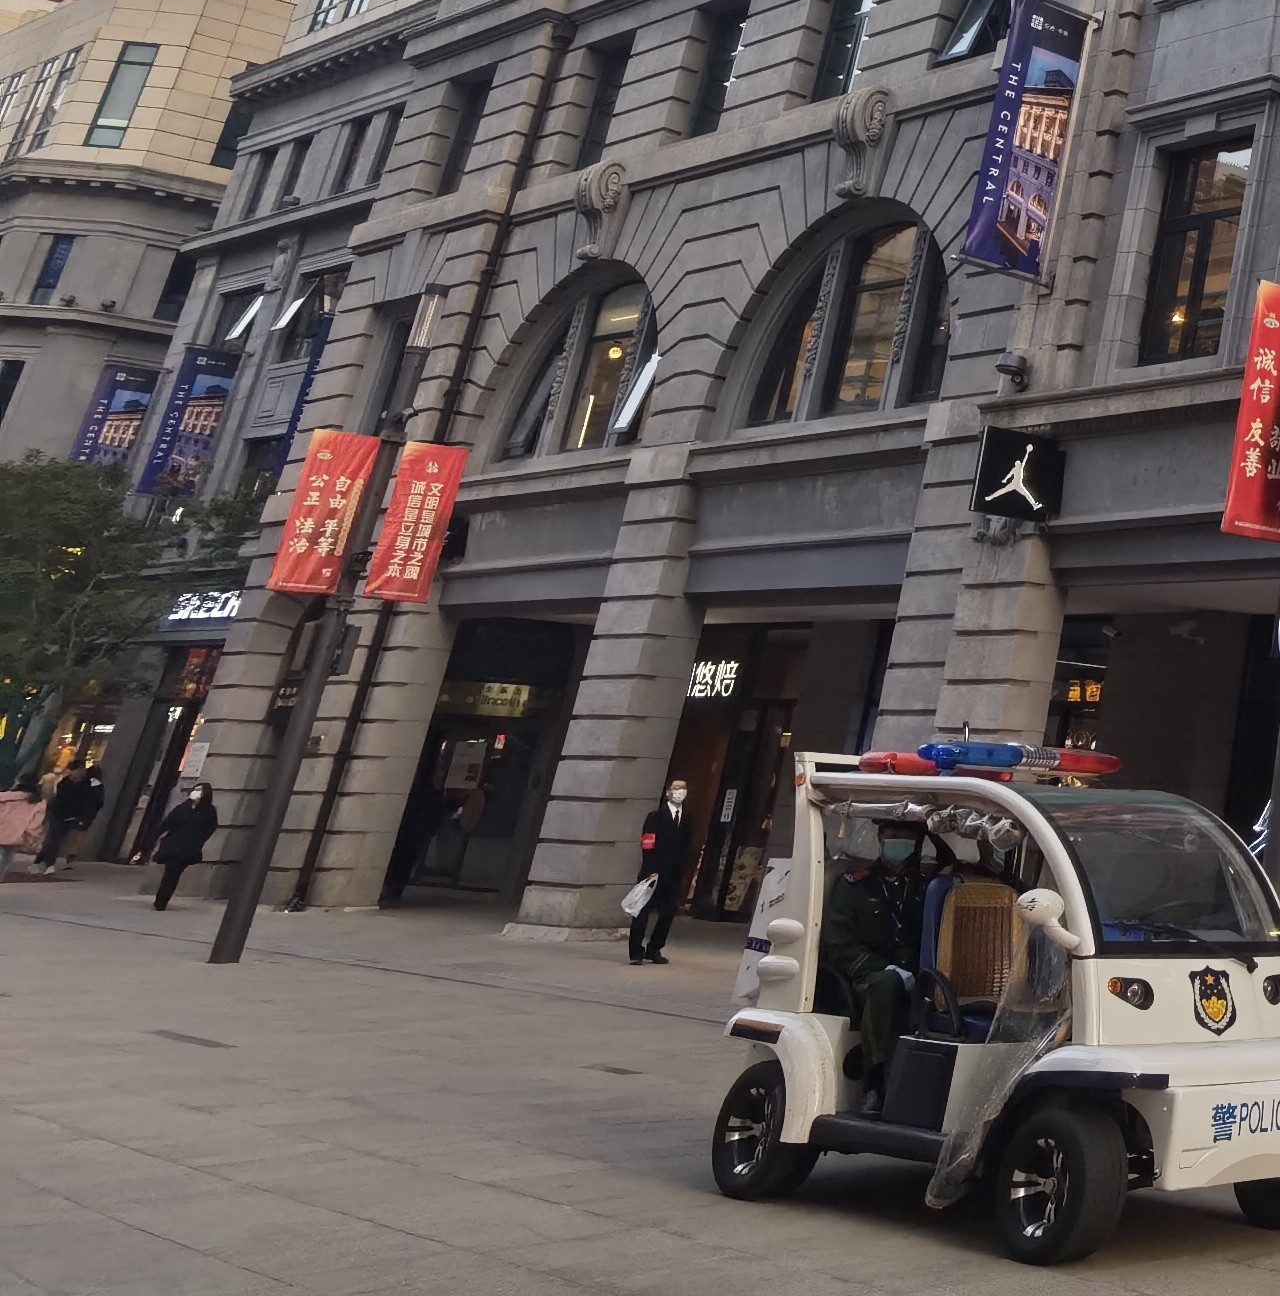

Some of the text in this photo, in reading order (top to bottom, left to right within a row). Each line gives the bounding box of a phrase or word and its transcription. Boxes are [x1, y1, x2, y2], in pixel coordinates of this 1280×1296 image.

[982, 62, 1022, 203] THE CENTRAL
[1240, 347, 1278, 478] 诚信 友善
[303, 473, 330, 506] 公正
[329, 476, 352, 509] 自由
[288, 517, 316, 554] 法治
[313, 518, 339, 557] 平等
